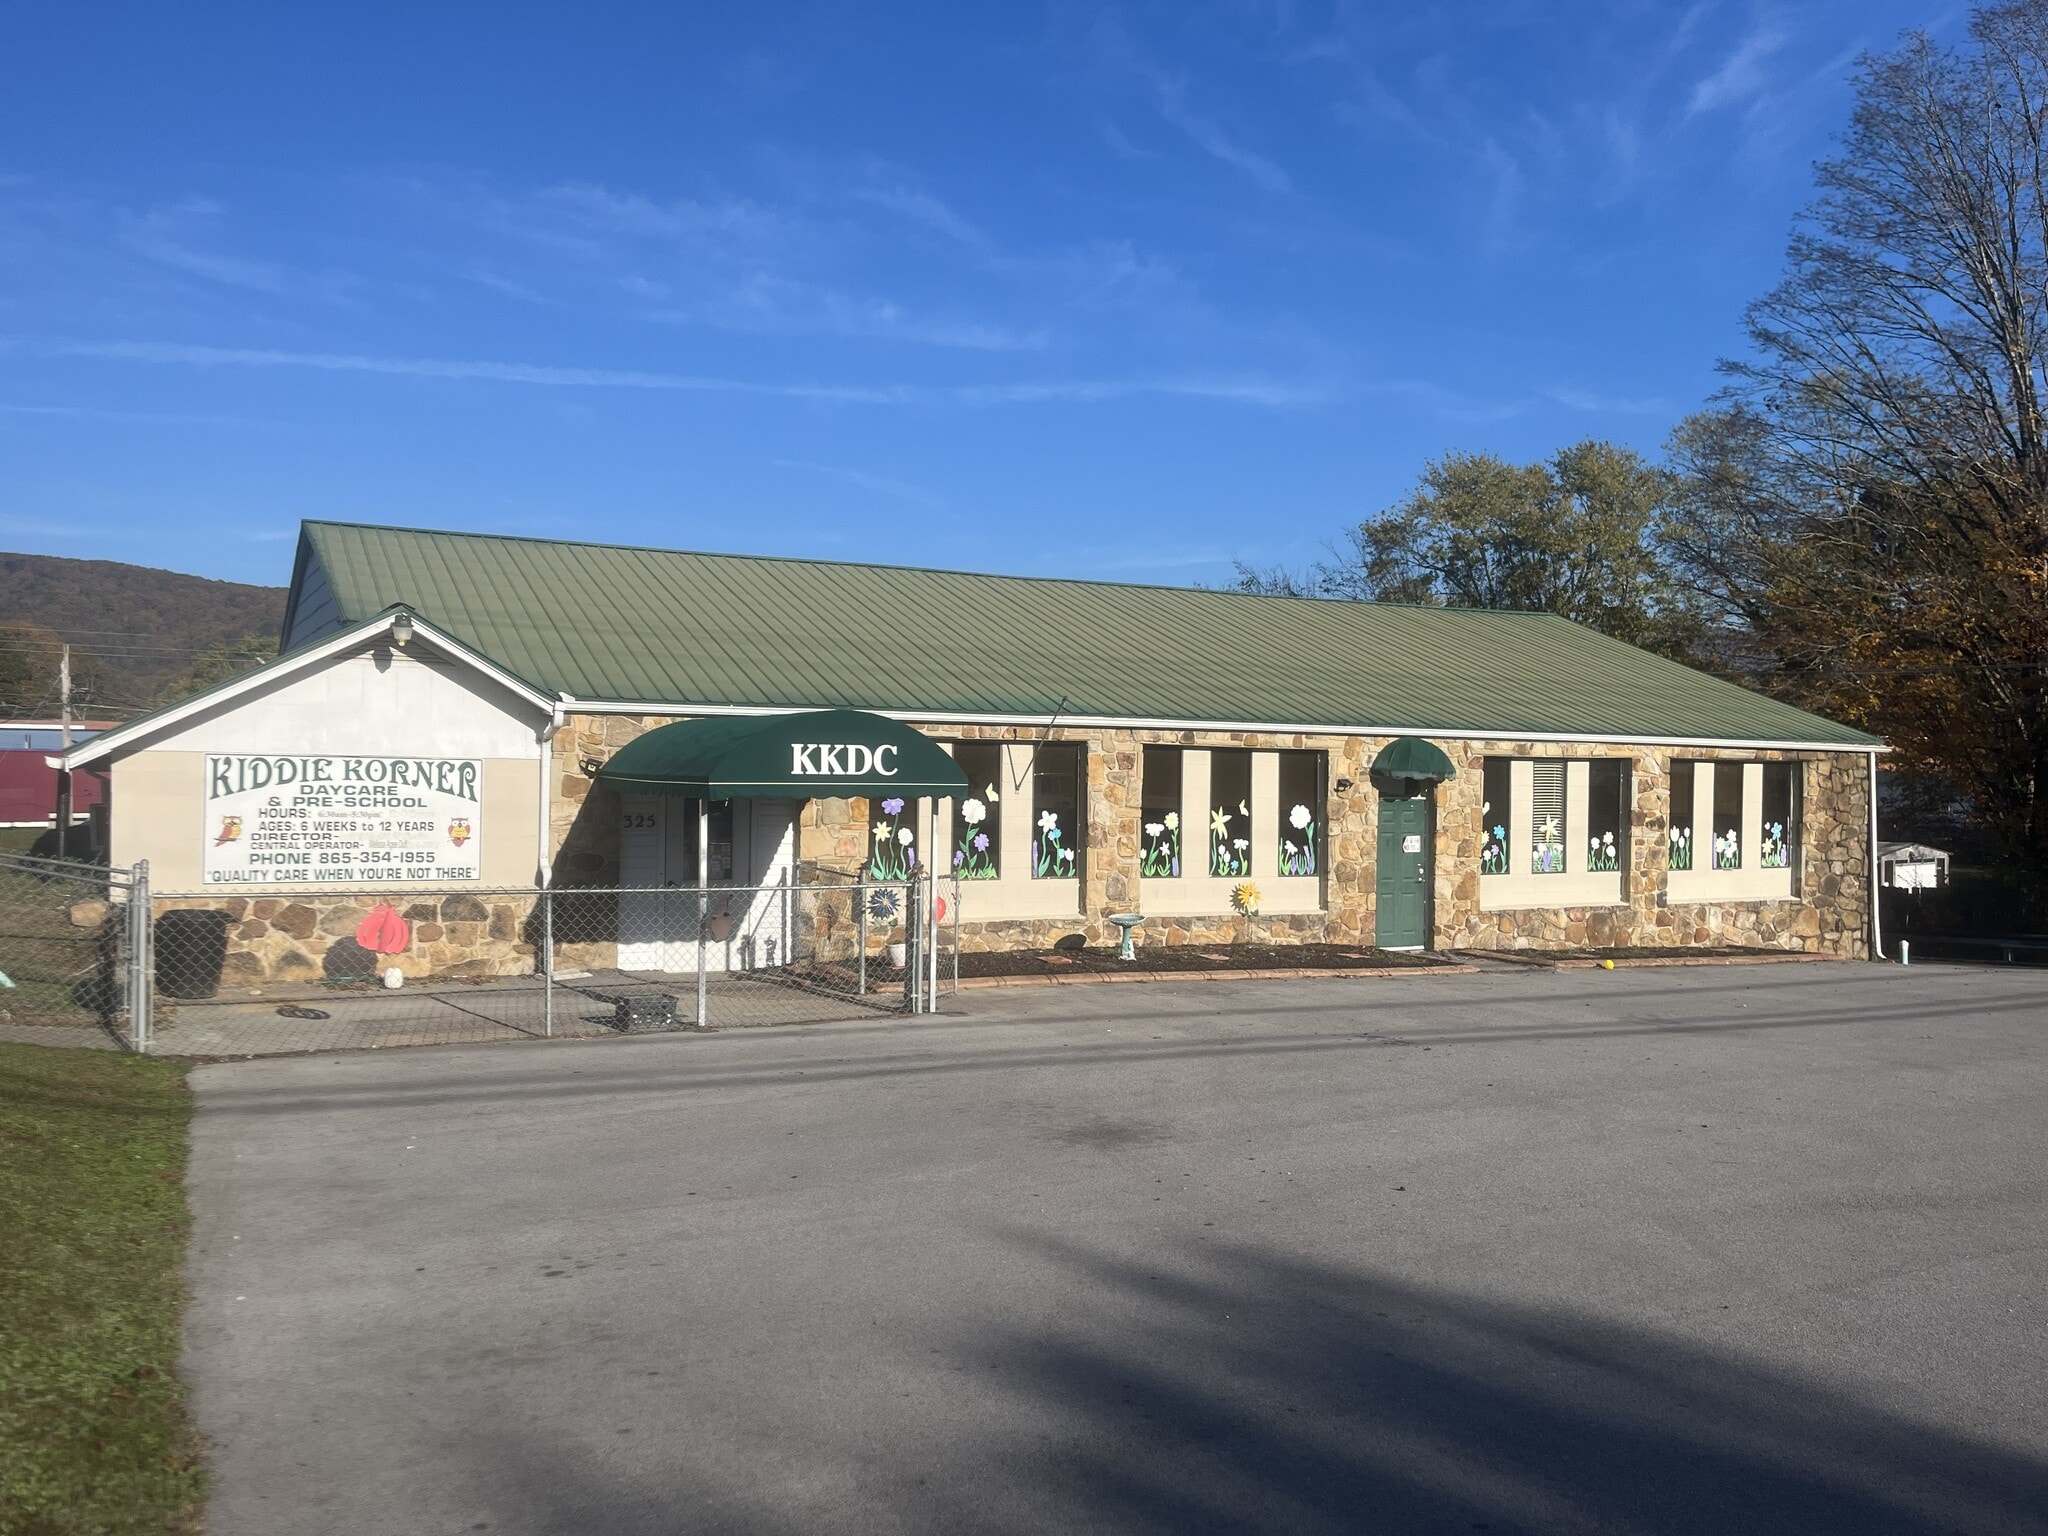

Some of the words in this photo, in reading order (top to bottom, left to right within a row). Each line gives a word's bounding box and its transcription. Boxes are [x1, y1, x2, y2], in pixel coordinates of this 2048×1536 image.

[791, 743, 898, 776] KKDC
[209, 756, 333, 800] KIDDIE
[342, 759, 478, 803] KORNER
[300, 784, 398, 796] DAYCARE
[268, 796, 282, 807] &
[293, 796, 428, 808] PRE-SCHOOL
[258, 808, 312, 819] HOURS:
[259, 821, 297, 832] AGES:
[301, 821, 308, 831] 6
[313, 821, 357, 831] WEEKS
[362, 822, 374, 831] to
[379, 821, 392, 831] 12
[396, 821, 435, 831] YEARS
[624, 814, 656, 829] 325
[250, 833, 340, 841] DIRECTOR-
[250, 841, 301, 850] CENTRAL
[304, 841, 364, 850] OPERATOR-
[249, 853, 312, 865] PHONE
[319, 851, 436, 864] 865-354-1955
[274, 868, 309, 880] CARE
[313, 868, 354, 880] WHEN
[358, 867, 402, 880] YOU'RE
[406, 867, 432, 879] NOT
